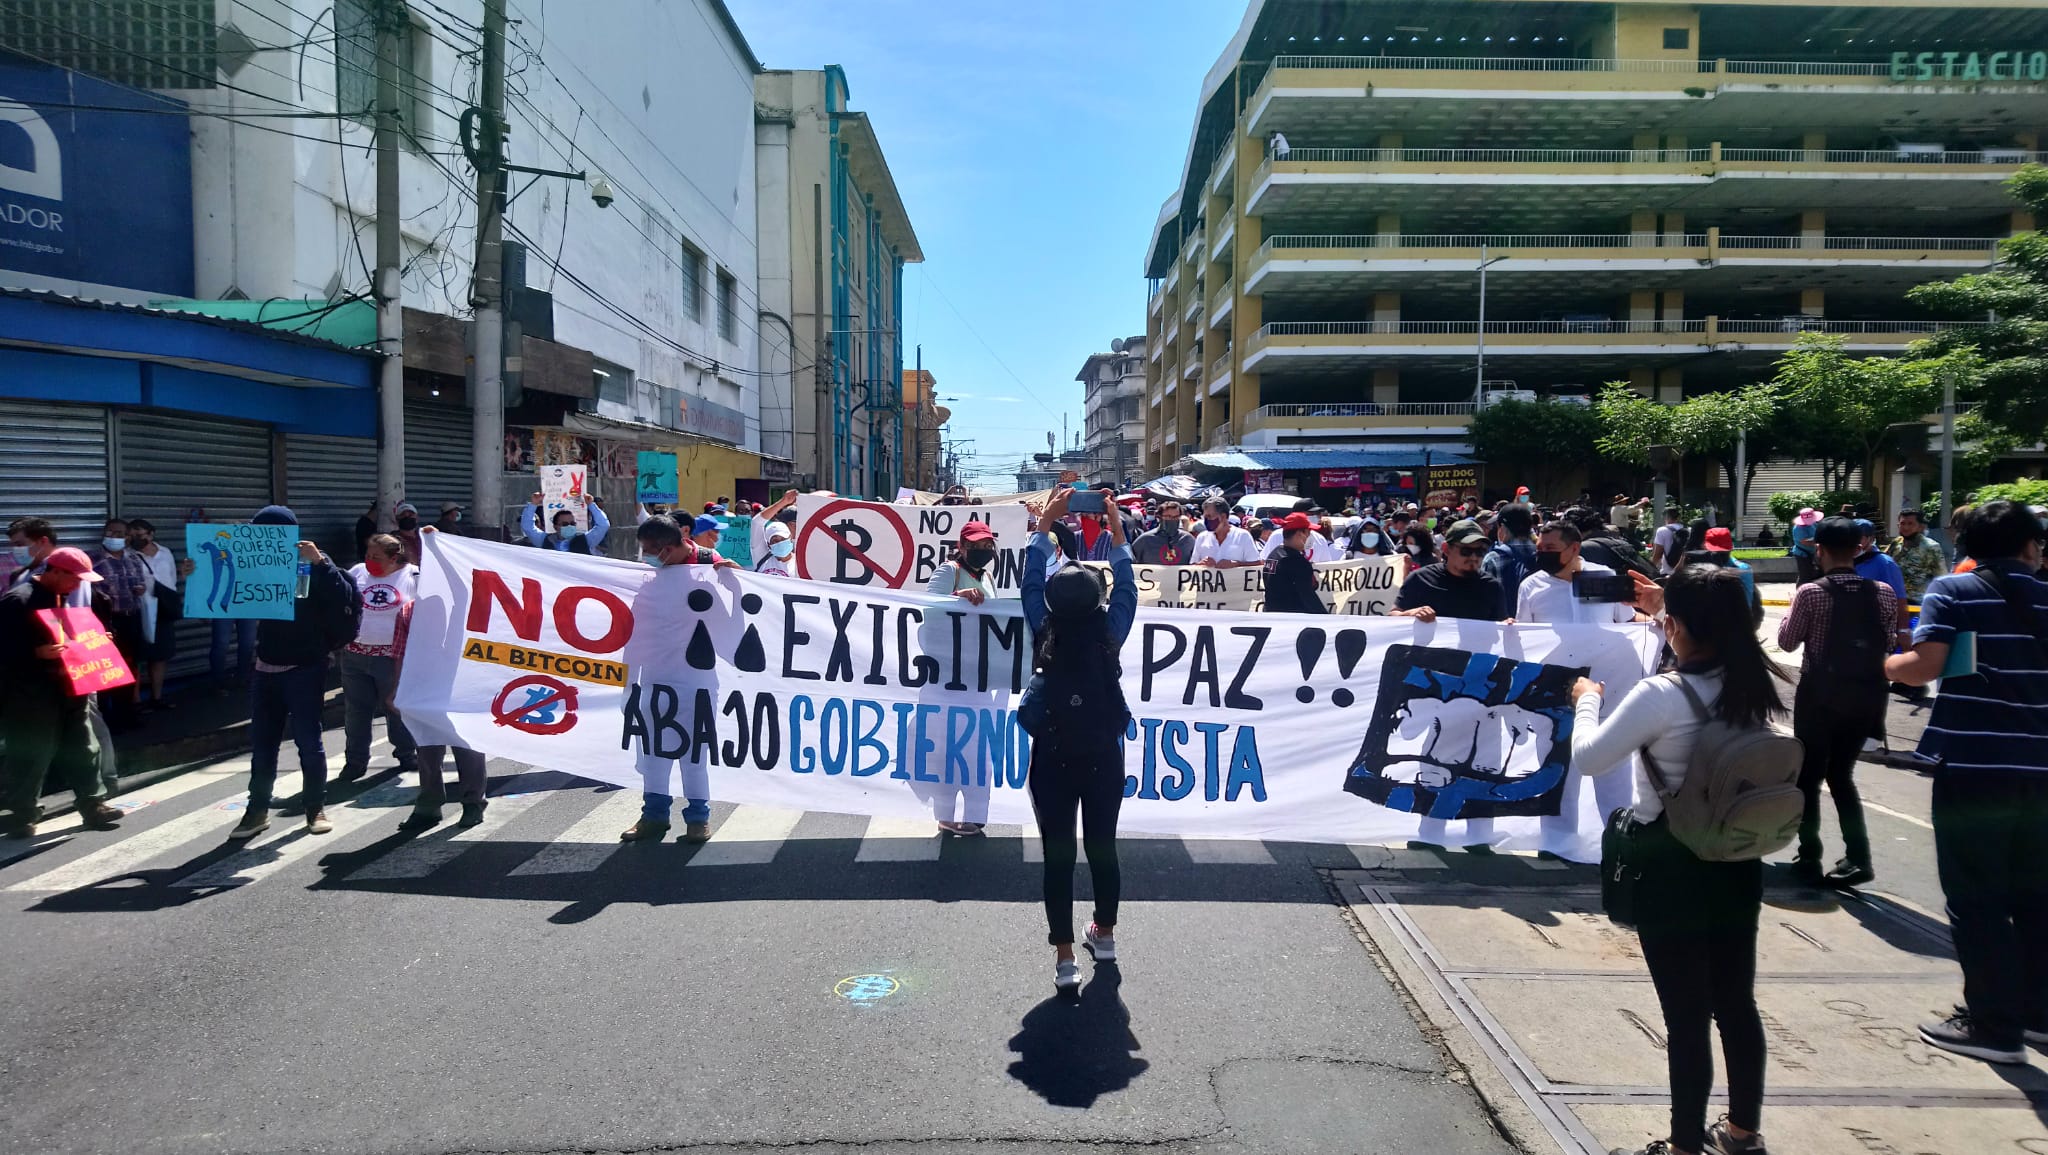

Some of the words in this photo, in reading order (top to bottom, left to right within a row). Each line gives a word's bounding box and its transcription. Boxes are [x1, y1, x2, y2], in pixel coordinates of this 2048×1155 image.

[1890, 51, 2048, 81] ESTACIO
[1428, 480, 1435, 488] Y
[1437, 479, 1477, 487] TORTAS
[1430, 470, 1451, 478] HOT
[1452, 469, 1474, 477] DOG
[233, 525, 287, 540] ¿QUIEN
[919, 510, 953, 536] NO
[232, 540, 287, 555] QUIERE
[723, 534, 747, 543] tcoin
[237, 552, 294, 569] BITCOIN?
[1178, 569, 1227, 593] PARA
[1244, 569, 1265, 592] EL
[1314, 566, 1395, 592] SARROLLO
[232, 581, 293, 606] ESSSTA!
[466, 568, 635, 655] NO
[685, 589, 1025, 694] ¡¡EXIGIM
[465, 642, 499, 661] AL
[509, 648, 623, 682] BITCOIN
[621, 683, 780, 771] ABAJO
[789, 694, 1030, 790] GOBIERNO
[1118, 717, 1268, 803] CISTA
